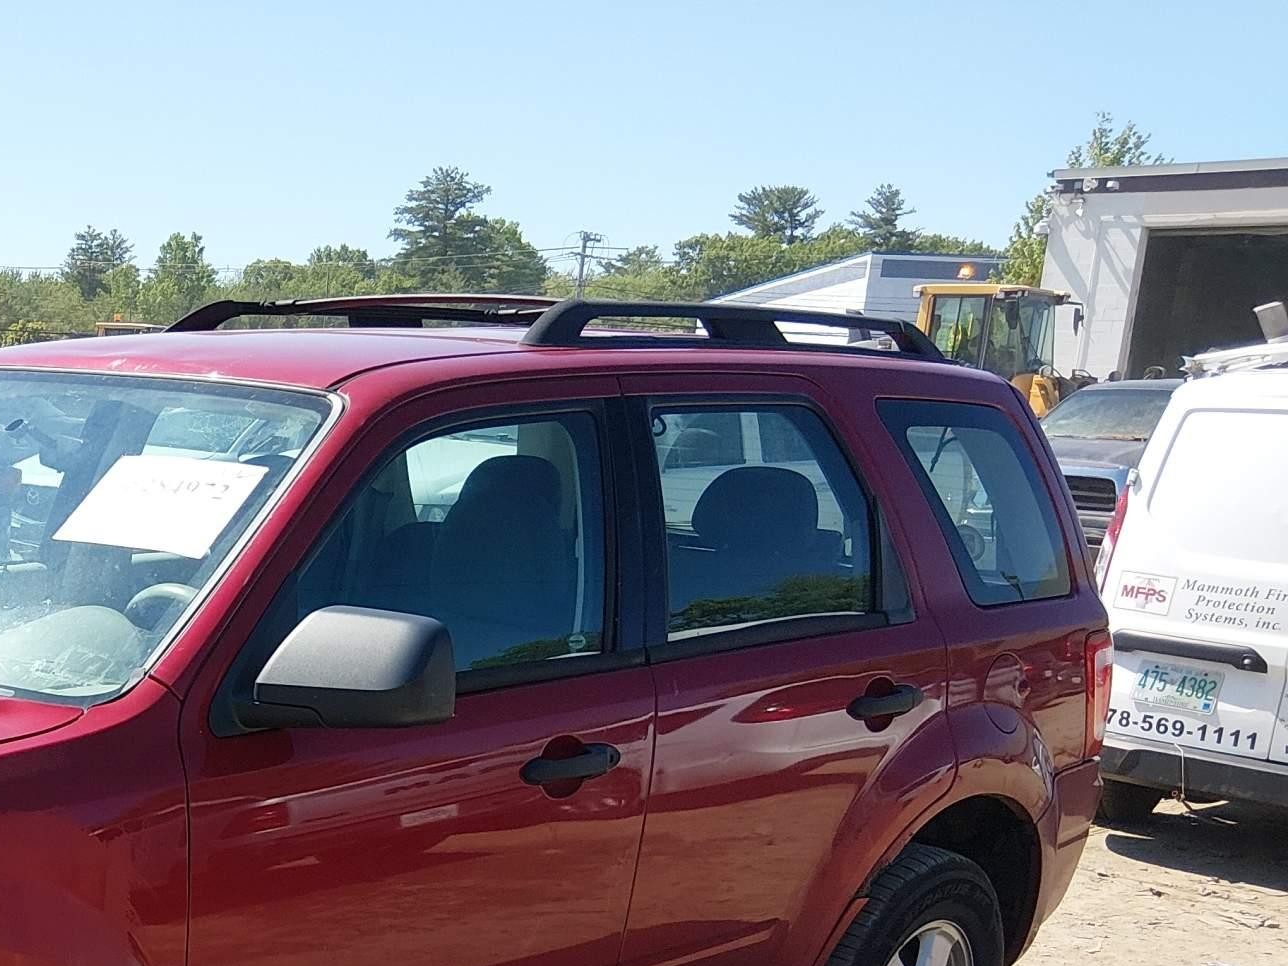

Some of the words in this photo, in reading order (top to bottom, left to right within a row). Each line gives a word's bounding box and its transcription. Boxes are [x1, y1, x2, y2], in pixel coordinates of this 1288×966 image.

[1120, 584, 1167, 604] MFPS
[1181, 579, 1260, 598] Mammoth
[1194, 595, 1276, 615] Protection
[1185, 608, 1249, 628] Systems,
[1255, 617, 1282, 631] inc.
